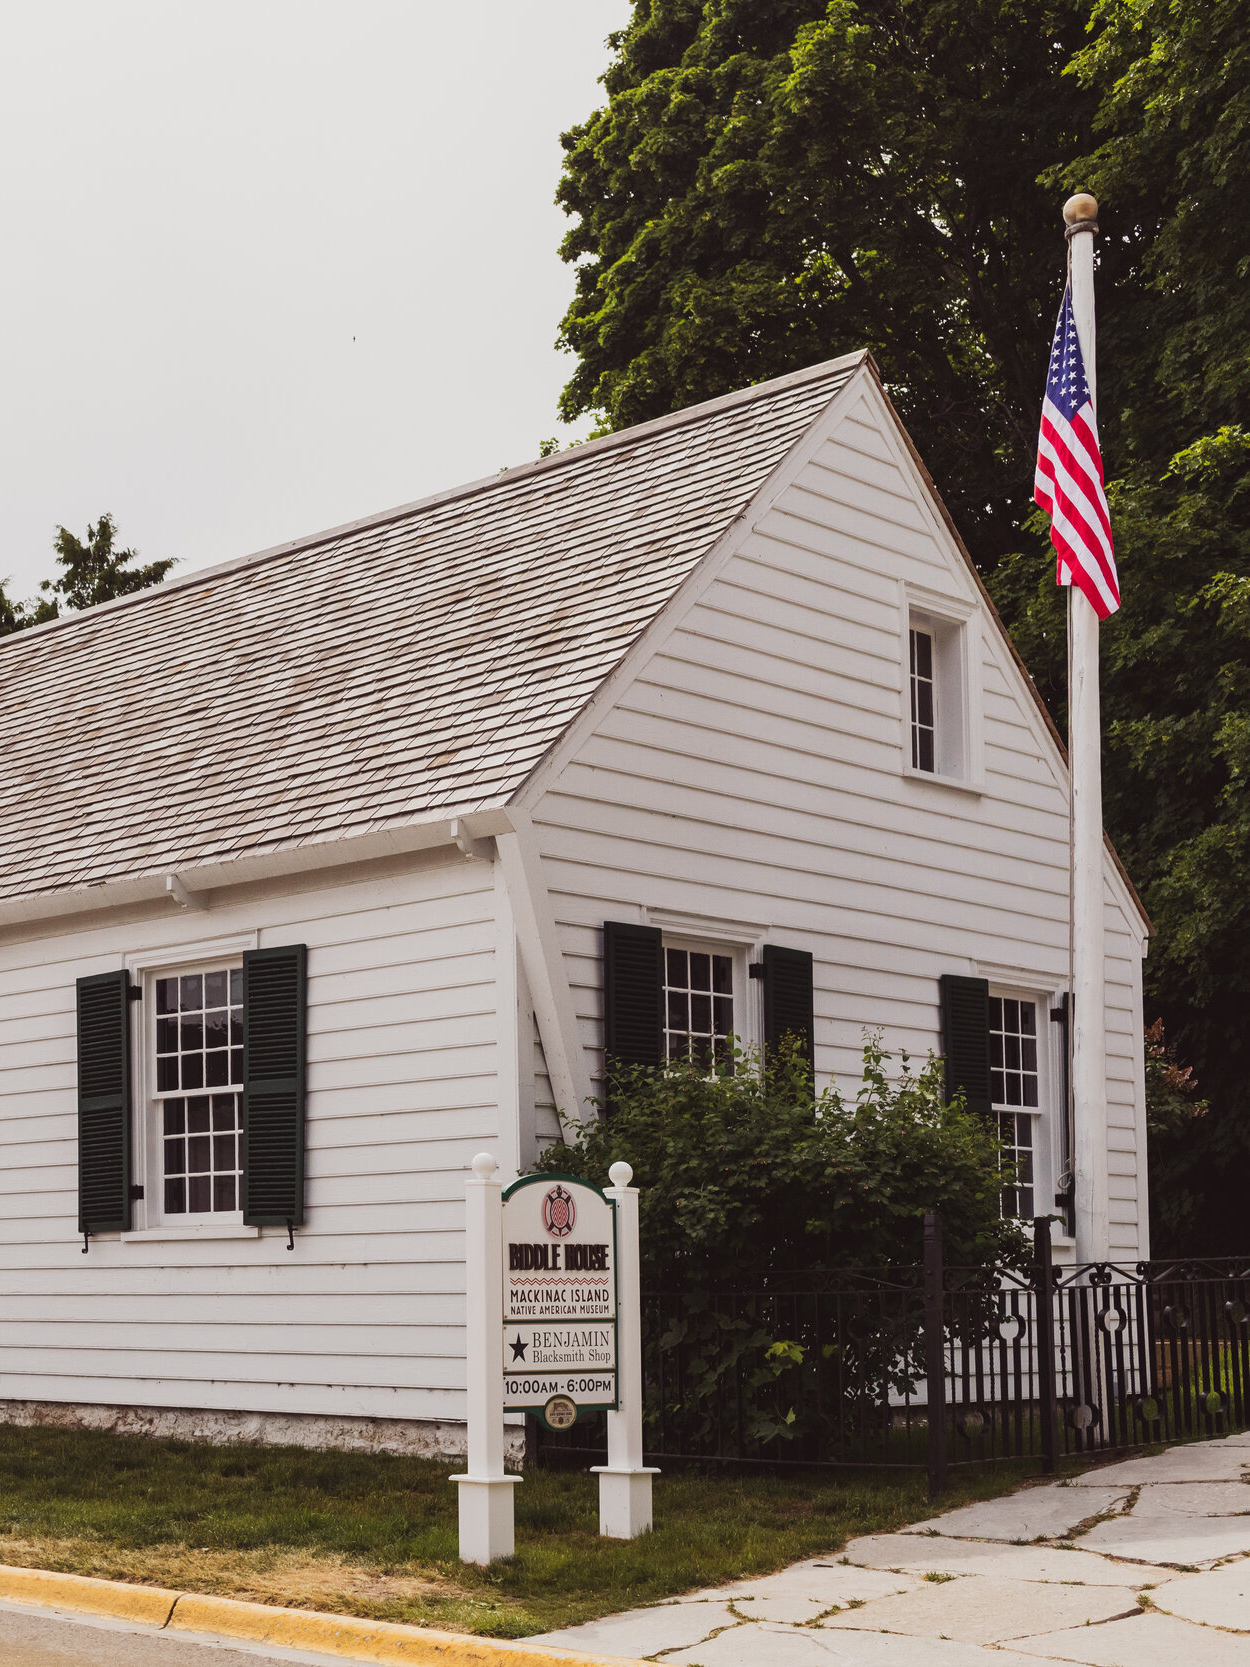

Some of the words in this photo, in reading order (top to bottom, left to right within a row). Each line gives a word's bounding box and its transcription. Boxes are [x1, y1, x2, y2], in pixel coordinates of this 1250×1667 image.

[508, 1243, 561, 1271] BIDDLE
[564, 1243, 610, 1271] HOUSE
[510, 1289, 566, 1303] MACKINAC
[571, 1288, 609, 1302] ISLAND
[510, 1305, 536, 1315] NATIVE
[539, 1305, 577, 1315] AMERICAN
[580, 1304, 610, 1314] MUSEUM
[532, 1330, 610, 1348] BENJAMIN
[532, 1349, 585, 1363] Blacksmith
[588, 1348, 611, 1363] Shop
[505, 1379, 558, 1394] 10:00AM
[566, 1379, 611, 1393] 6:00PM
